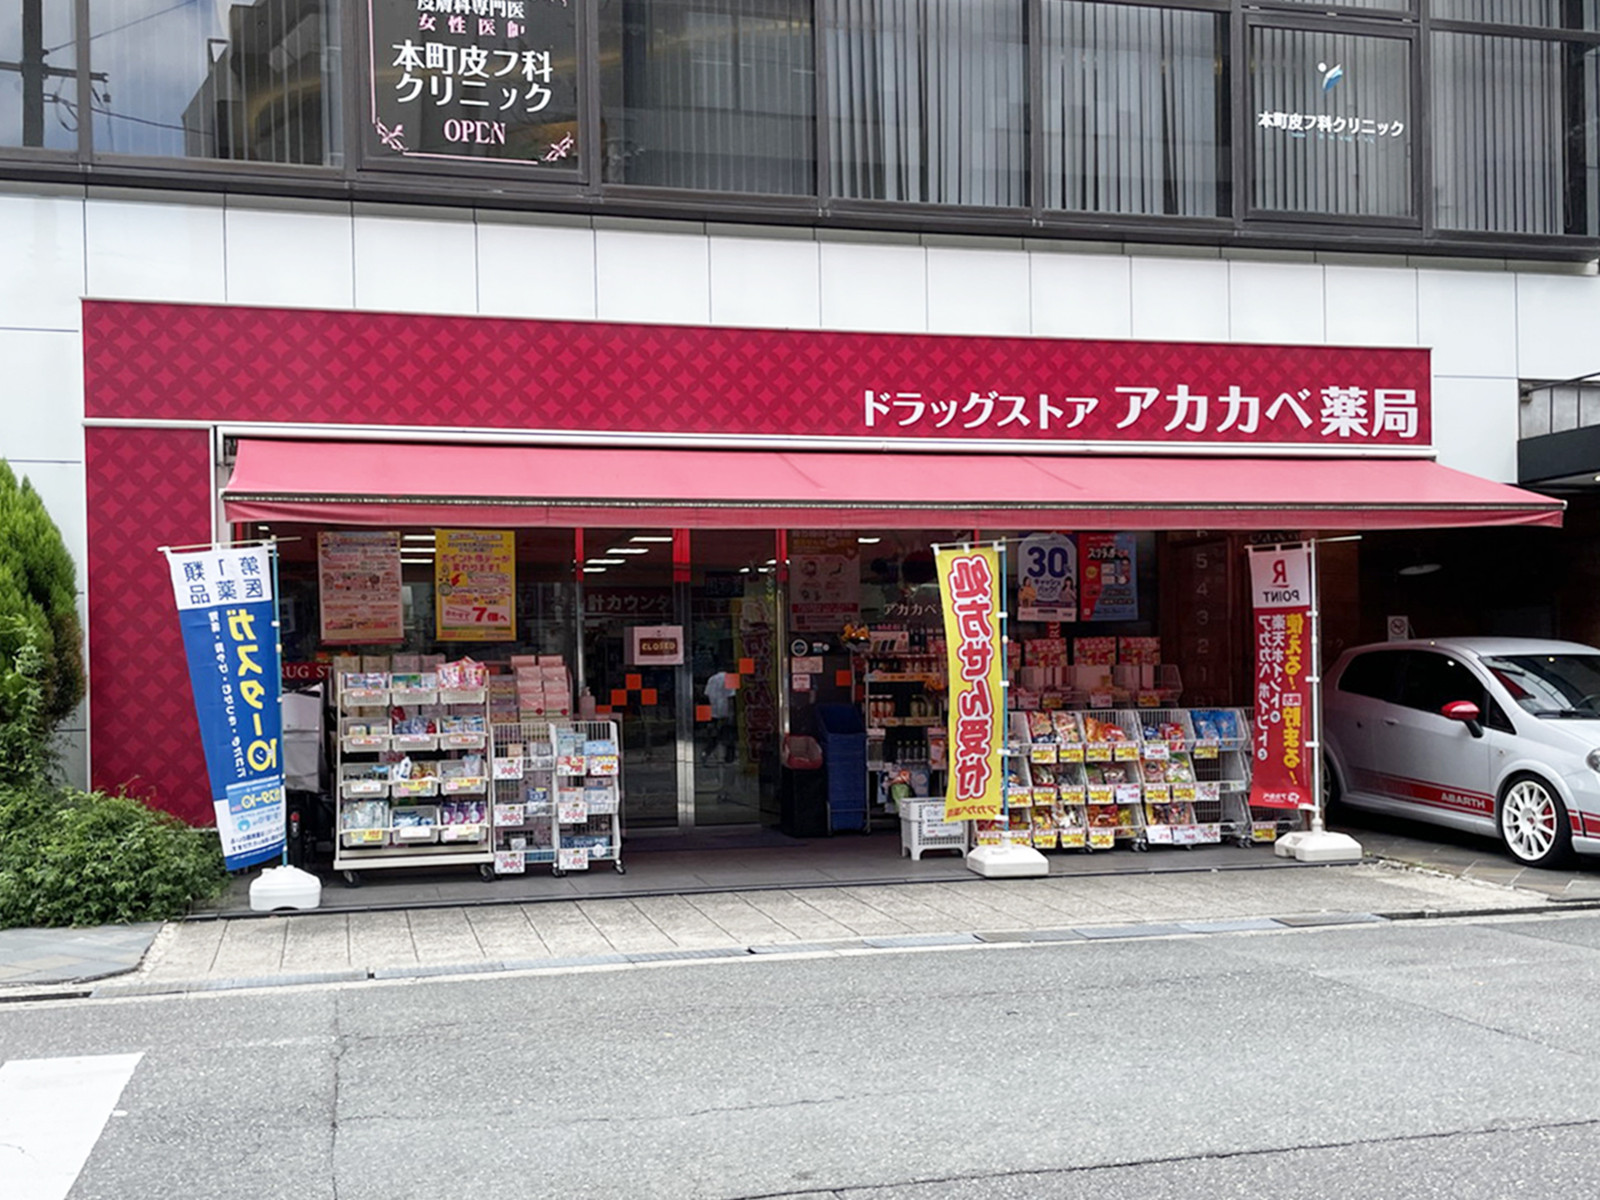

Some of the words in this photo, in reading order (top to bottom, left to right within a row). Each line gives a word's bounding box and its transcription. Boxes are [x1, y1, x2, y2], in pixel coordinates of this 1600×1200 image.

[392, 39, 553, 83] 本町皮フ科
[395, 73, 551, 113] クリニック
[1257, 111, 1405, 138] 本町皮フ科クリニック
[864, 389, 1099, 430] ドラッグストア
[1114, 384, 1418, 438] アカカベ薬局
[641, 640, 676, 651] CLOSED
[1440, 792, 1486, 809] ABARTH
